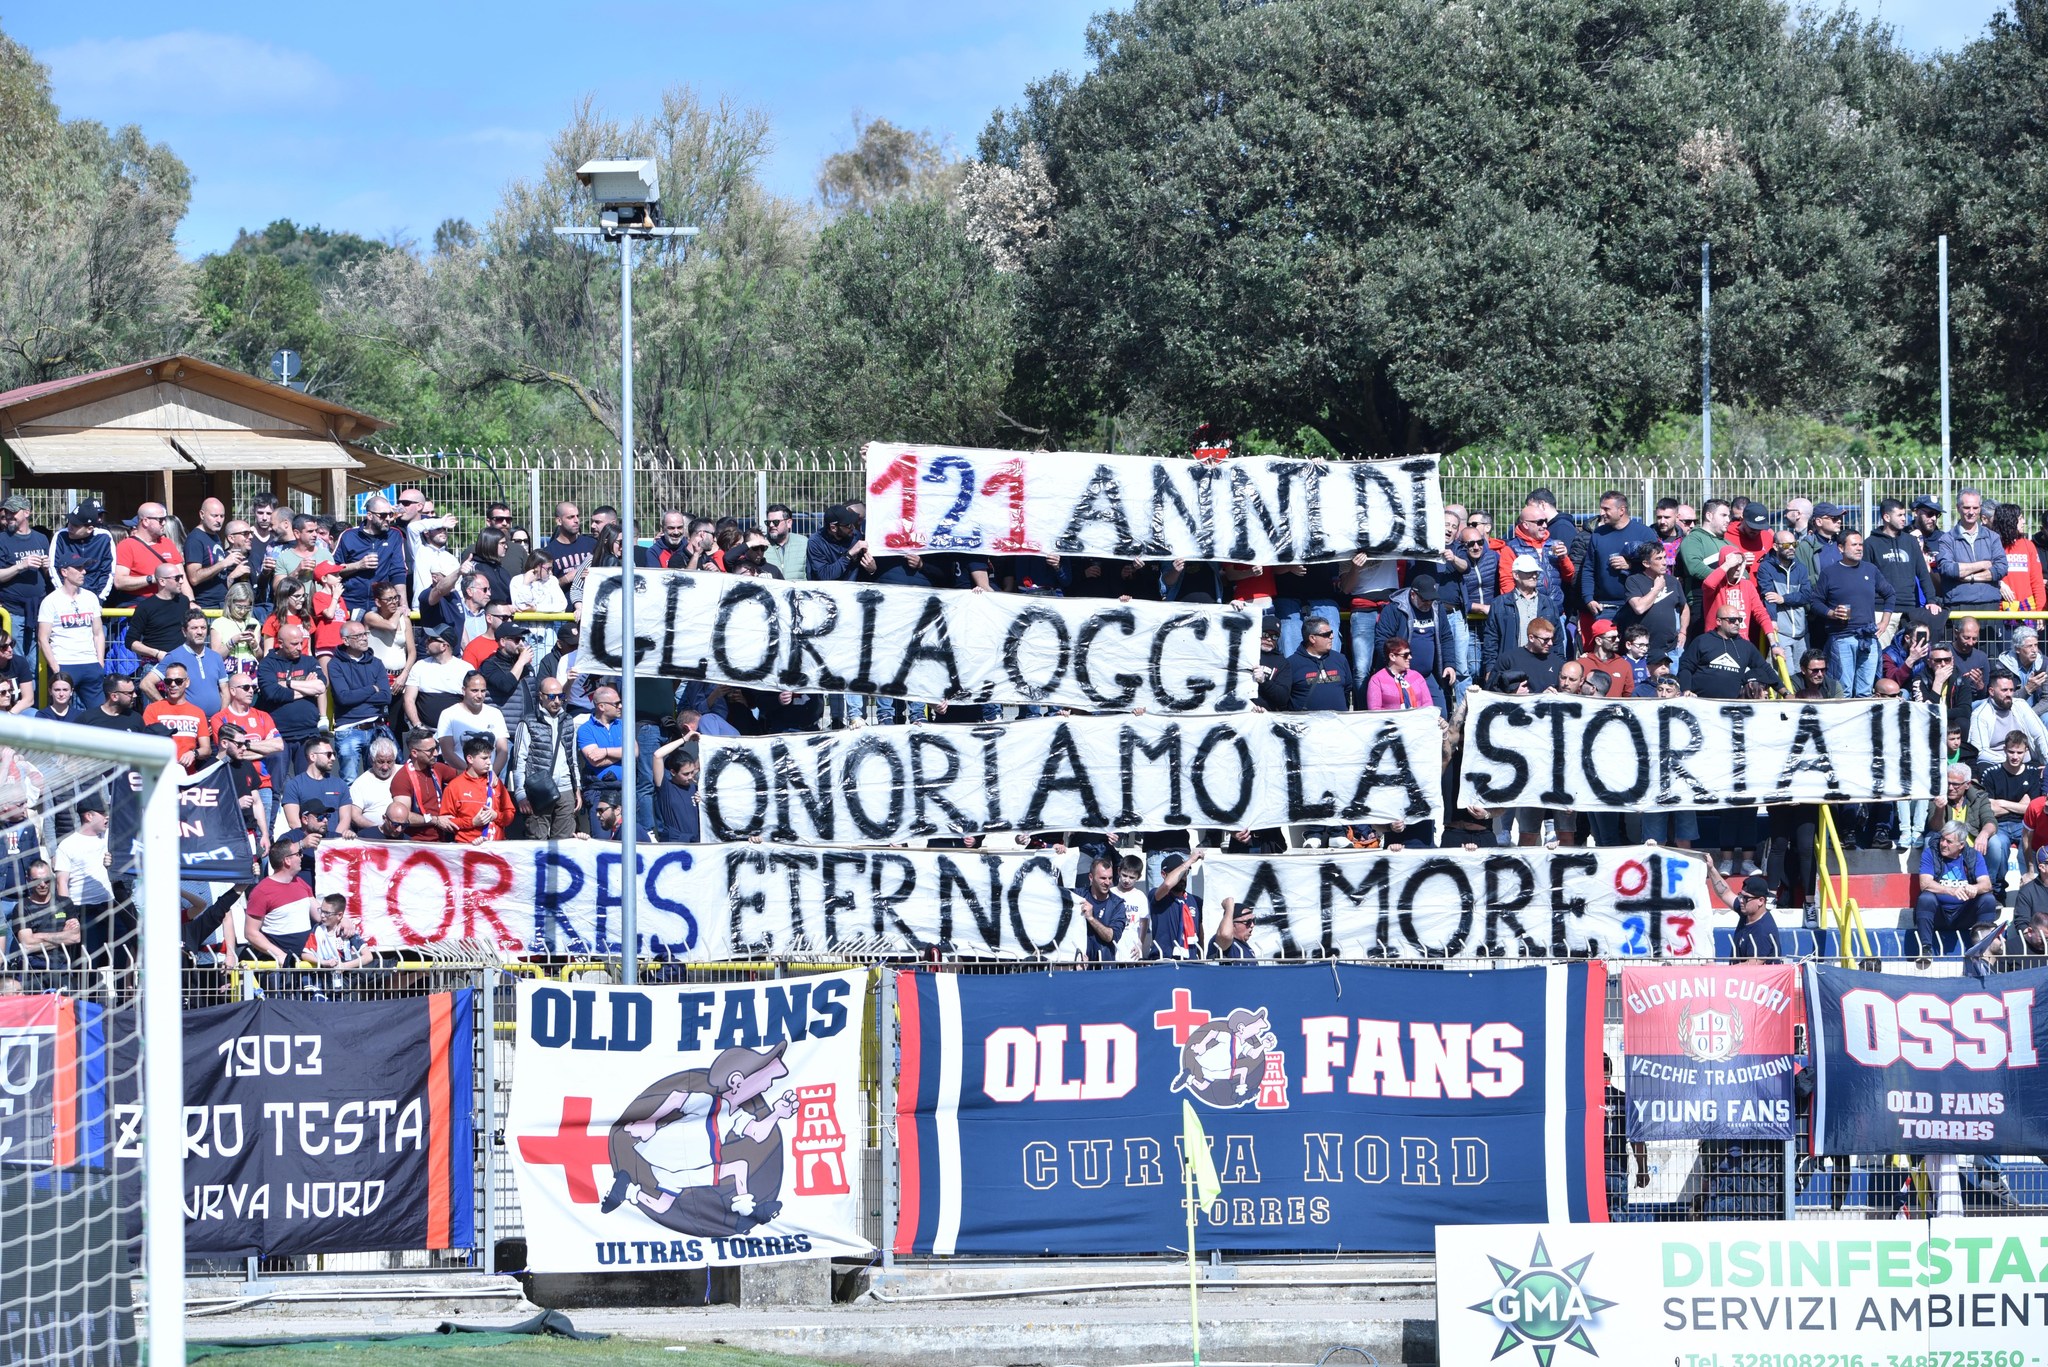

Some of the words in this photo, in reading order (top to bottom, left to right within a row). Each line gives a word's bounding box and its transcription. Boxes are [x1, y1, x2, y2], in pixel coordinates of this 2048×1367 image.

[870, 452, 1041, 553] 121
[1055, 459, 1336, 563] ANNI
[1351, 458, 1440, 558] DI
[1002, 607, 1254, 712] OGGI
[160, 719, 198, 733] TORRES
[1465, 702, 1851, 807] STORIA
[321, 848, 698, 954] TORRES
[726, 848, 1072, 954] ETERNO
[1242, 853, 1598, 959] AMORE
[530, 987, 653, 1052] OLD
[678, 978, 851, 1052] FANS
[1627, 977, 1716, 1014] GIOVANI
[1724, 978, 1791, 1015] CUORI
[1840, 987, 2039, 1071] OSSI
[218, 1034, 322, 1077] 1903
[984, 1022, 1137, 1102] OLD
[1301, 1016, 1525, 1099] FANS
[1632, 1056, 1697, 1084] VECCHIE
[1704, 1055, 1792, 1085] TRADIZIONI
[1634, 1100, 1717, 1123] YOUNG
[1727, 1100, 1790, 1122] FANS
[1887, 1090, 1933, 1114] OLD
[1940, 1092, 2005, 1115] FANS
[114, 1104, 244, 1158] ZRO
[264, 1097, 423, 1156] TESTA
[1898, 1118, 1994, 1141] TORRES
[1303, 1133, 1489, 1186] NORD
[181, 1183, 270, 1221] URVA
[286, 1180, 385, 1219] NORD
[1181, 1196, 1330, 1227] TORRES
[596, 1239, 703, 1265] ULTRAS
[711, 1233, 812, 1261] TORRES
[1491, 1285, 1593, 1322] GMA
[1663, 1296, 1837, 1332] SERVIZI
[1685, 1353, 1725, 1367] Tel
[1732, 1352, 1863, 1367] 3281082216
[1886, 1350, 2025, 1367] 3485725360
